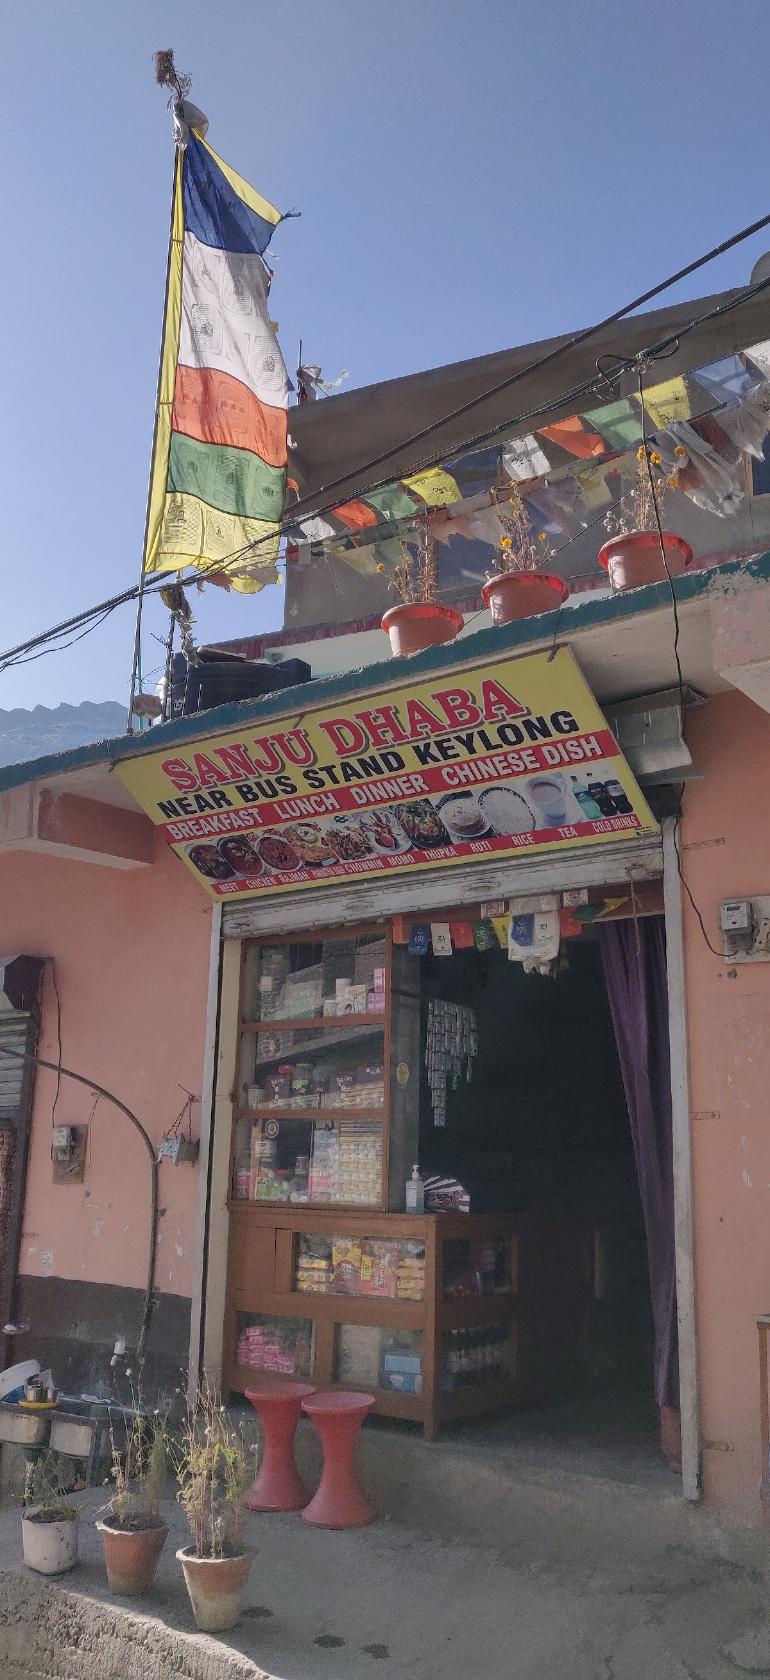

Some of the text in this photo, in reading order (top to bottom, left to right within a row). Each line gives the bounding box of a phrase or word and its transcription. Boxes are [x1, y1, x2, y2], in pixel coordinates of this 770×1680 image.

[157, 710, 579, 819] NEAR BUS STAND KEYLONG
[161, 679, 528, 793] SANJU DHABA
[167, 735, 603, 840] BREAKFAST LUNCH DINNER CHINESE DISH
[218, 882, 240, 893] MEET
[245, 876, 277, 889] CHICKEN
[279, 871, 310, 883] RAJMAH
[344, 859, 385, 873] CHOWMIN
[387, 853, 415, 867] MOMO
[423, 846, 458, 860] THUPKA
[469, 841, 493, 854] ROTI
[511, 833, 535, 846] RICE
[558, 826, 578, 838] TEA
[591, 821, 611, 833] COLD
[611, 816, 638, 830] DRINKS
